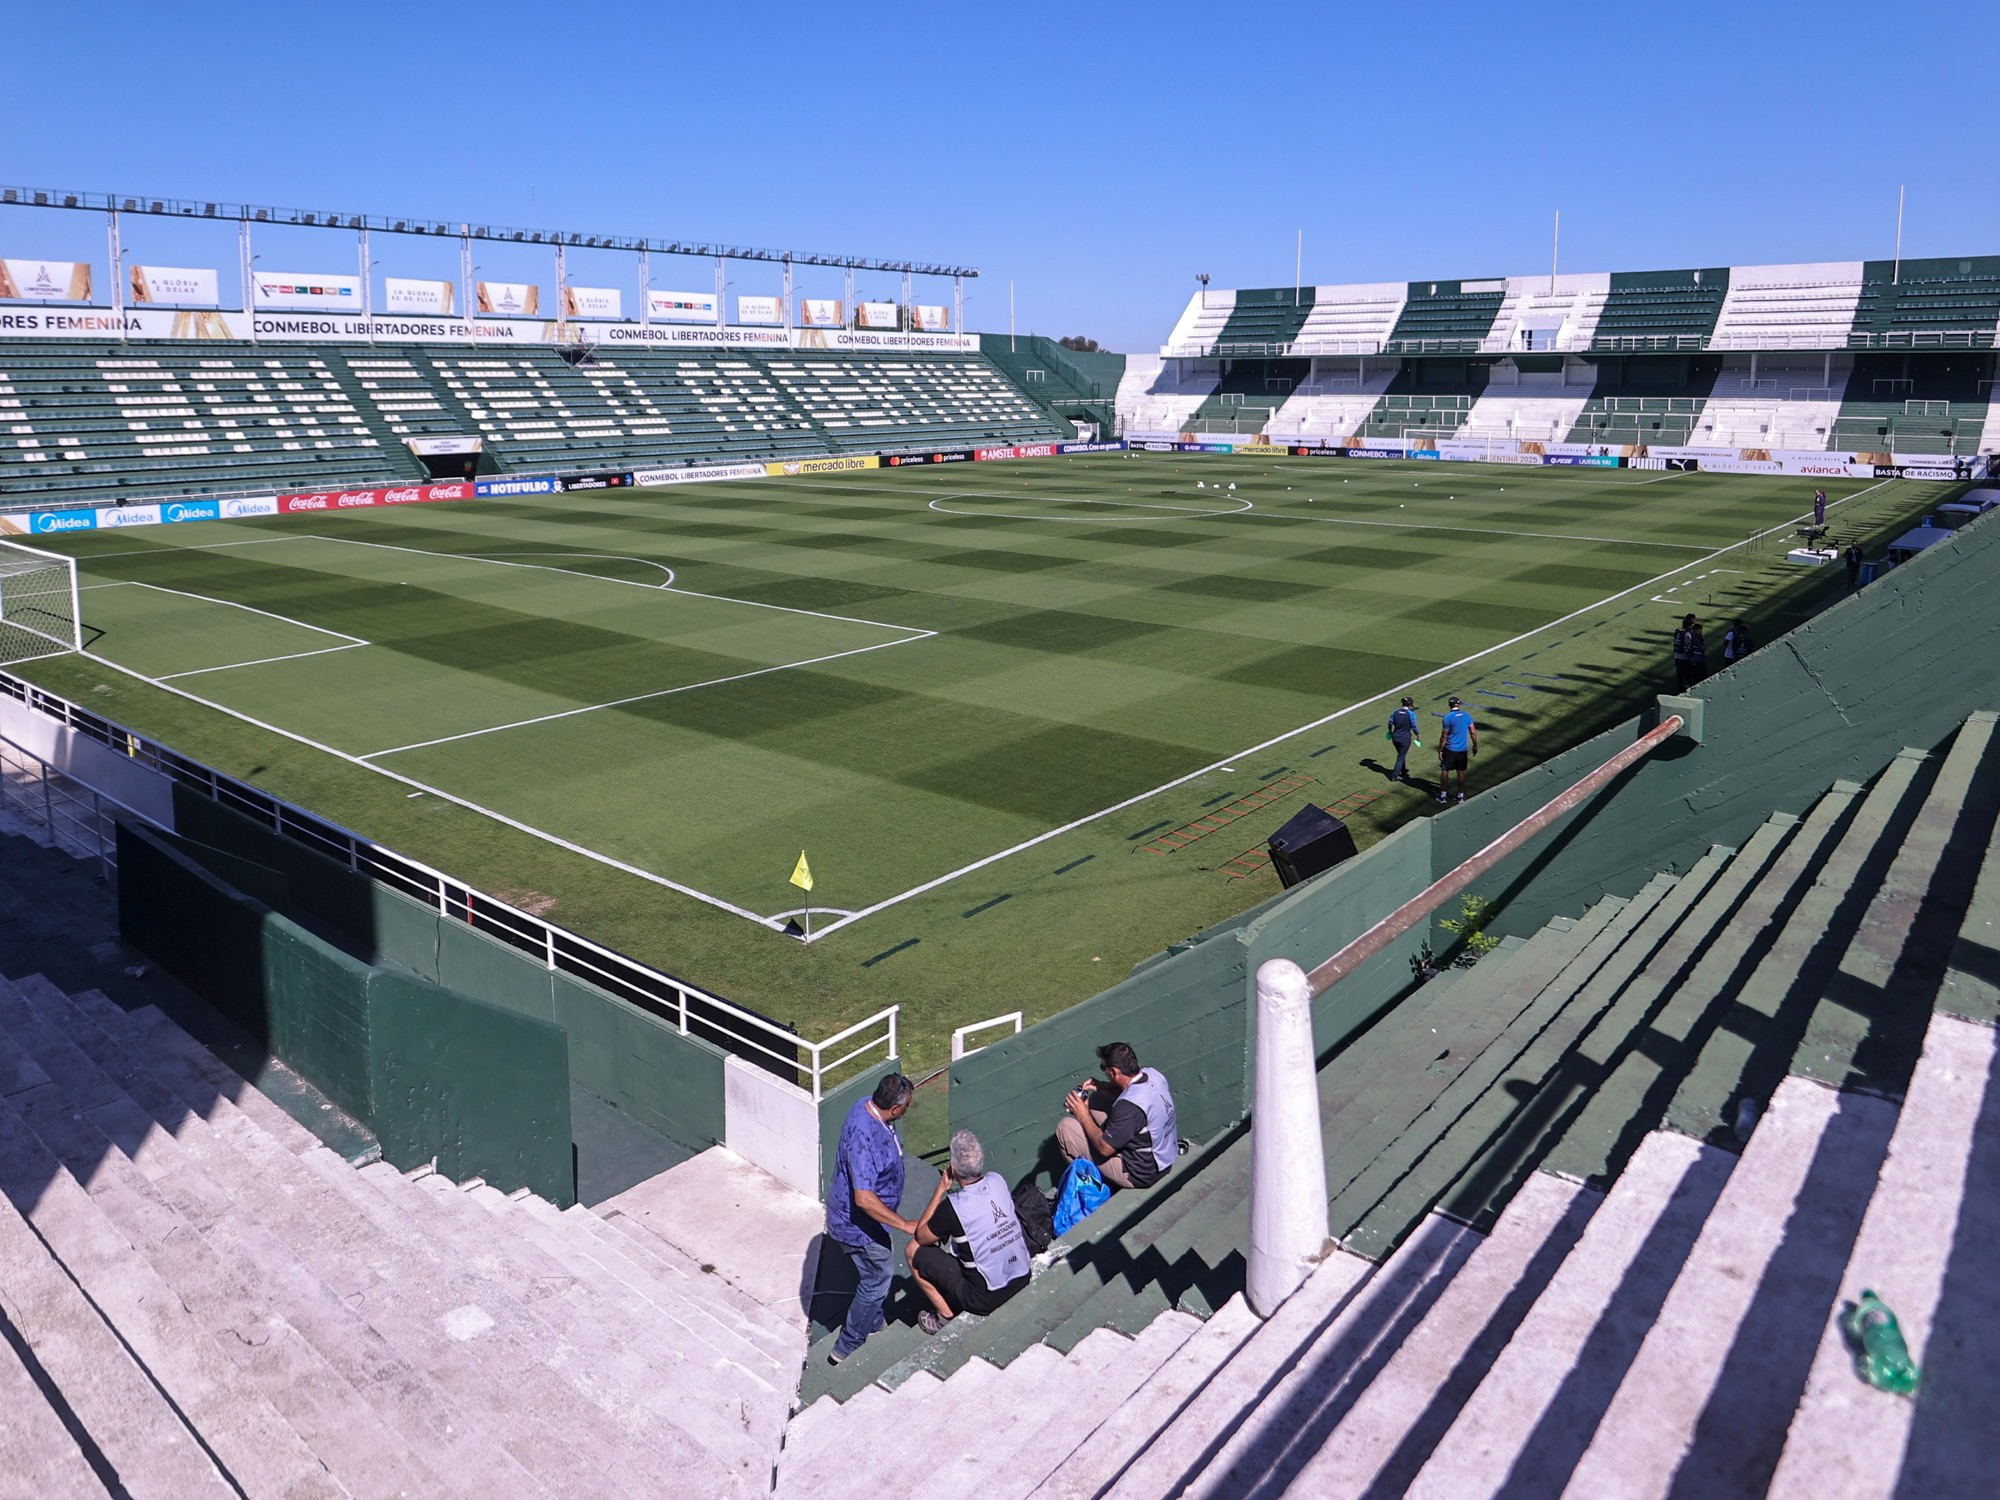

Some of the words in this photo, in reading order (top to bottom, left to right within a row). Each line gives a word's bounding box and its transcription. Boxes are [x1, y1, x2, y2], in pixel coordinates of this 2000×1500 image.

[156, 284, 161, 292] É
[162, 278, 200, 287] GLÓRIA
[46, 316, 142, 331] FEMENINA
[254, 320, 340, 334] CONMEBOL
[345, 323, 445, 336] LIBERTADORES
[450, 324, 514, 337] FEMENINA
[610, 329, 668, 340] CONMEBOL
[672, 330, 740, 342] LIBERTADORES
[744, 332, 788, 342] FEMENINA
[837, 334, 882, 344] CONMEBOL
[883, 336, 934, 346] LIBERTADORES
[936, 338, 970, 347] FEMENINA
[986, 448, 1015, 459] AMSTEL
[1026, 446, 1052, 456] AMSTEL
[1063, 444, 1088, 452] CONMEBOL
[901, 456, 923, 465] priceless
[943, 454, 964, 462] priceless
[1628, 458, 1666, 470] PUMA
[803, 462, 844, 472] mercado
[845, 459, 864, 469] libre
[1800, 465, 1841, 474] avianca
[640, 472, 679, 482] CONMEBOL
[680, 470, 728, 480] LIBERTADORES
[730, 468, 761, 476] FEMENINA
[490, 481, 549, 495] NOTIFULBO
[568, 481, 606, 489] LIBERTADORES
[178, 506, 214, 519] Midea
[235, 503, 271, 515] Midea
[50, 516, 90, 530] Midea
[114, 512, 154, 526] Midea
